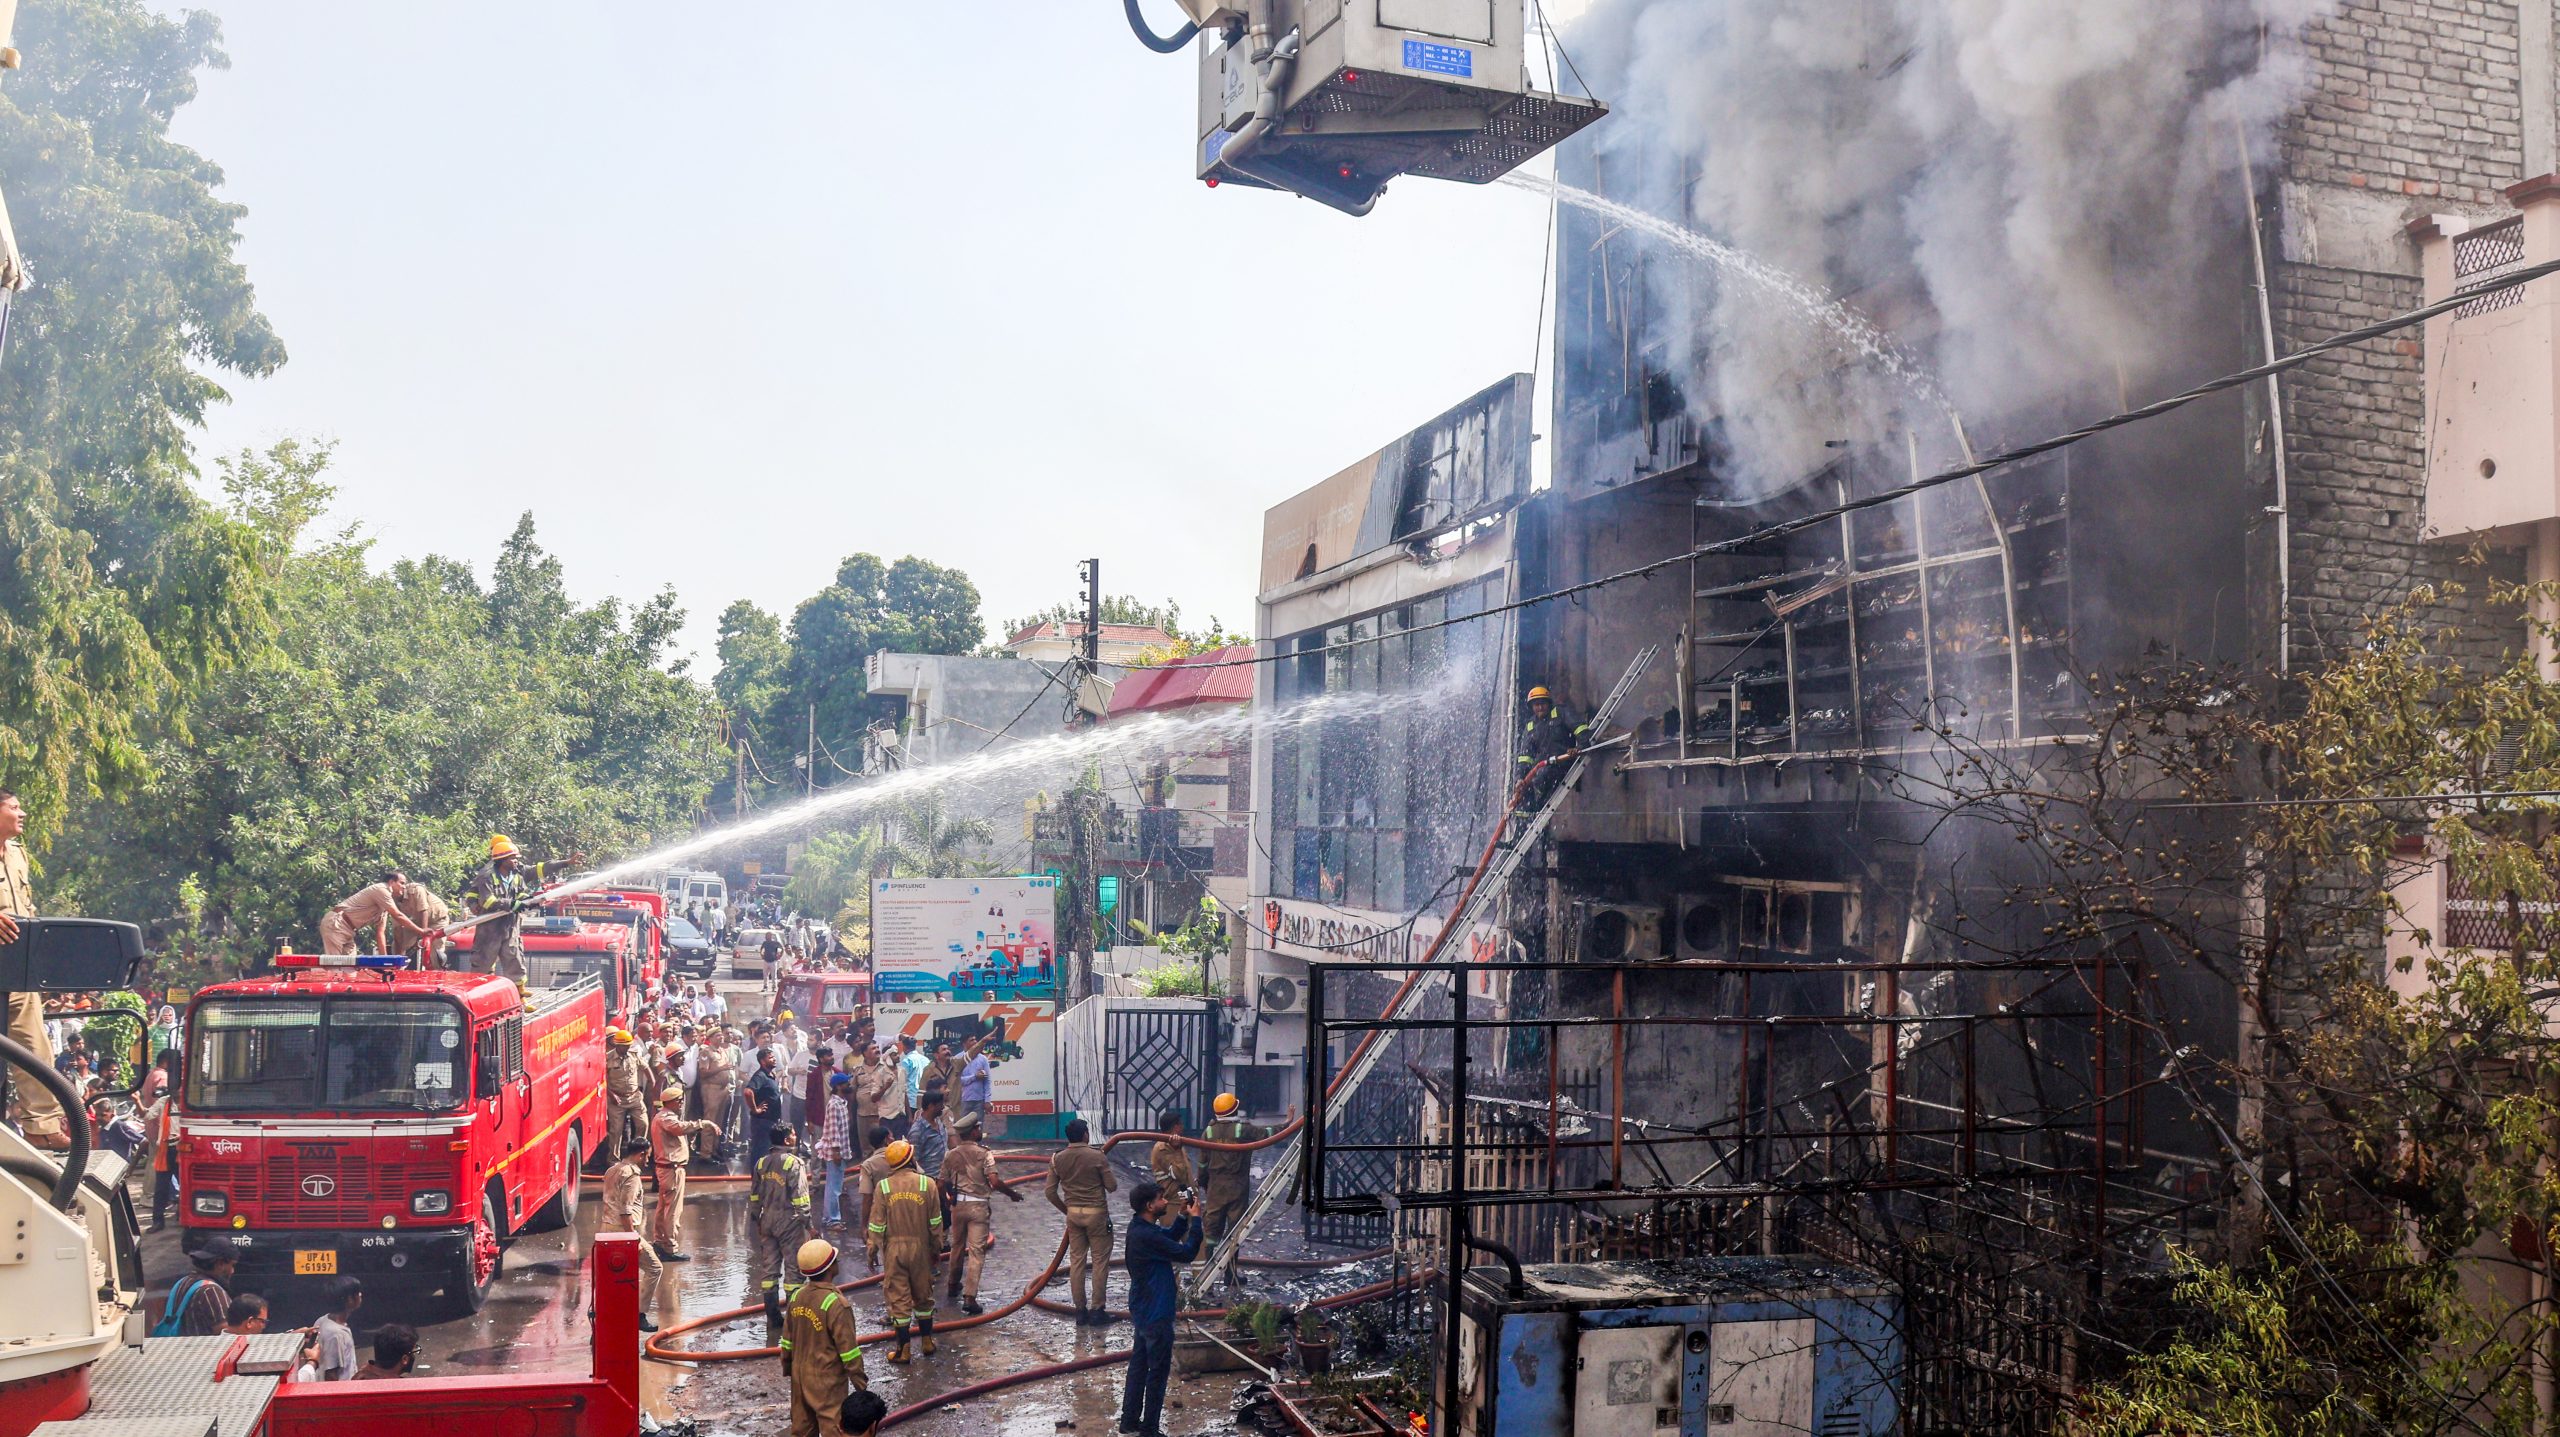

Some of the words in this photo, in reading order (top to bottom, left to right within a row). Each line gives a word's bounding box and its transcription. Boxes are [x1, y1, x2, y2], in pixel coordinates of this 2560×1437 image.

[578, 909, 591, 917] FIRE
[591, 910, 613, 918] SERVICE
[993, 1079, 1020, 1087] GAMING
[211, 1138, 242, 1156] पुलिस
[306, 1252, 318, 1262] UP
[320, 1252, 330, 1262] 41
[304, 1262, 332, 1272] G1997
